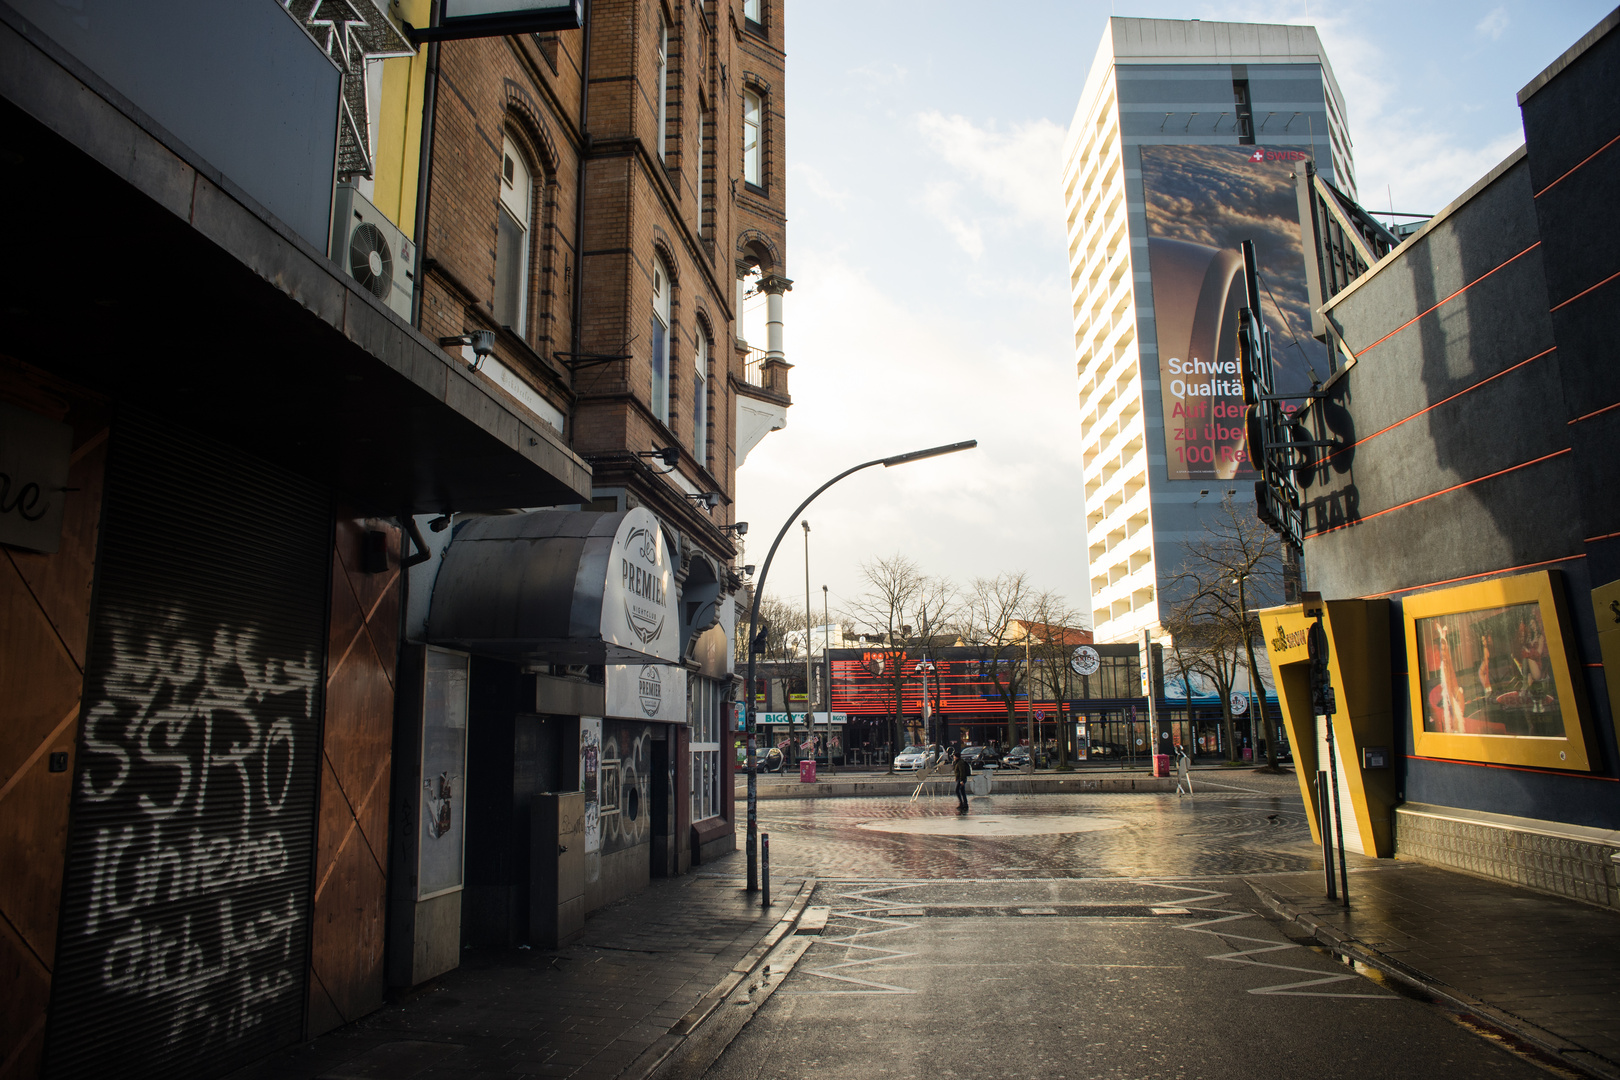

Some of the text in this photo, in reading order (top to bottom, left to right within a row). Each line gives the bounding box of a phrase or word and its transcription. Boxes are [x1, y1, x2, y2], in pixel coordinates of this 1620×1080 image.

[1266, 151, 1306, 161] SWISS
[1172, 401, 1207, 418] Auf
[1174, 427, 1197, 441] zu
[1175, 446, 1214, 463] 100
[622, 558, 667, 608] PREMIER
[639, 680, 661, 698] PREMIER
